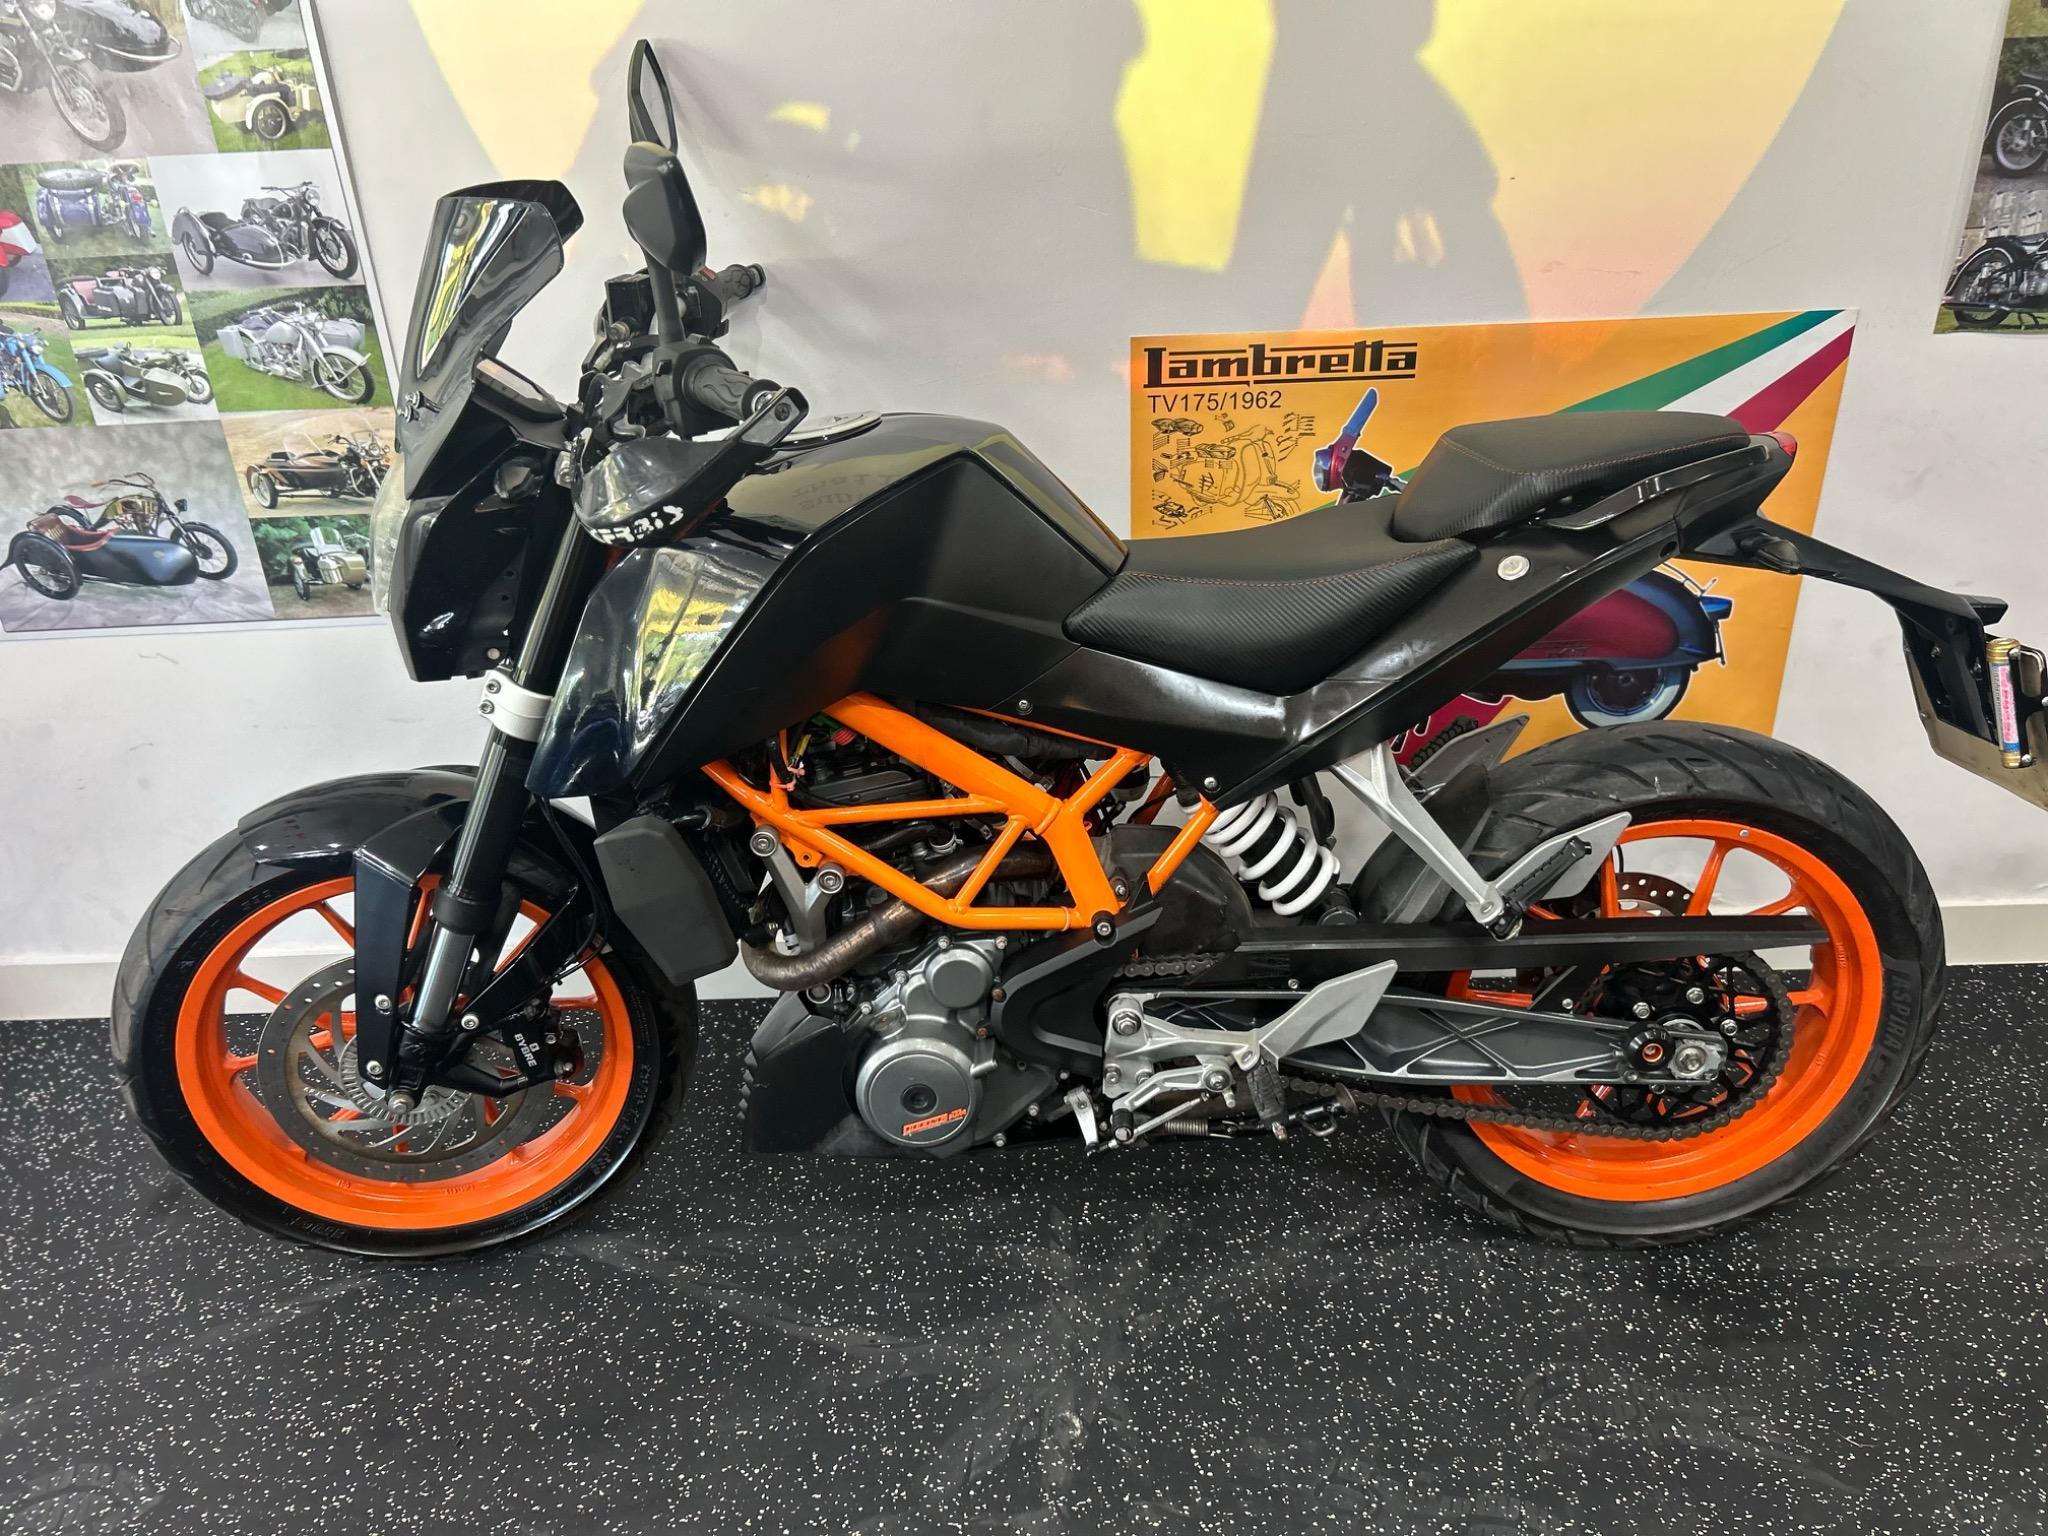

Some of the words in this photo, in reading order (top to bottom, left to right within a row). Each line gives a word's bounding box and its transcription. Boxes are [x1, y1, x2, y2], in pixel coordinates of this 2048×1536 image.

[1143, 340, 1418, 388] Lambretta
[1147, 390, 1283, 414] TV175/1962
[514, 1033, 538, 1068] BYBRE
